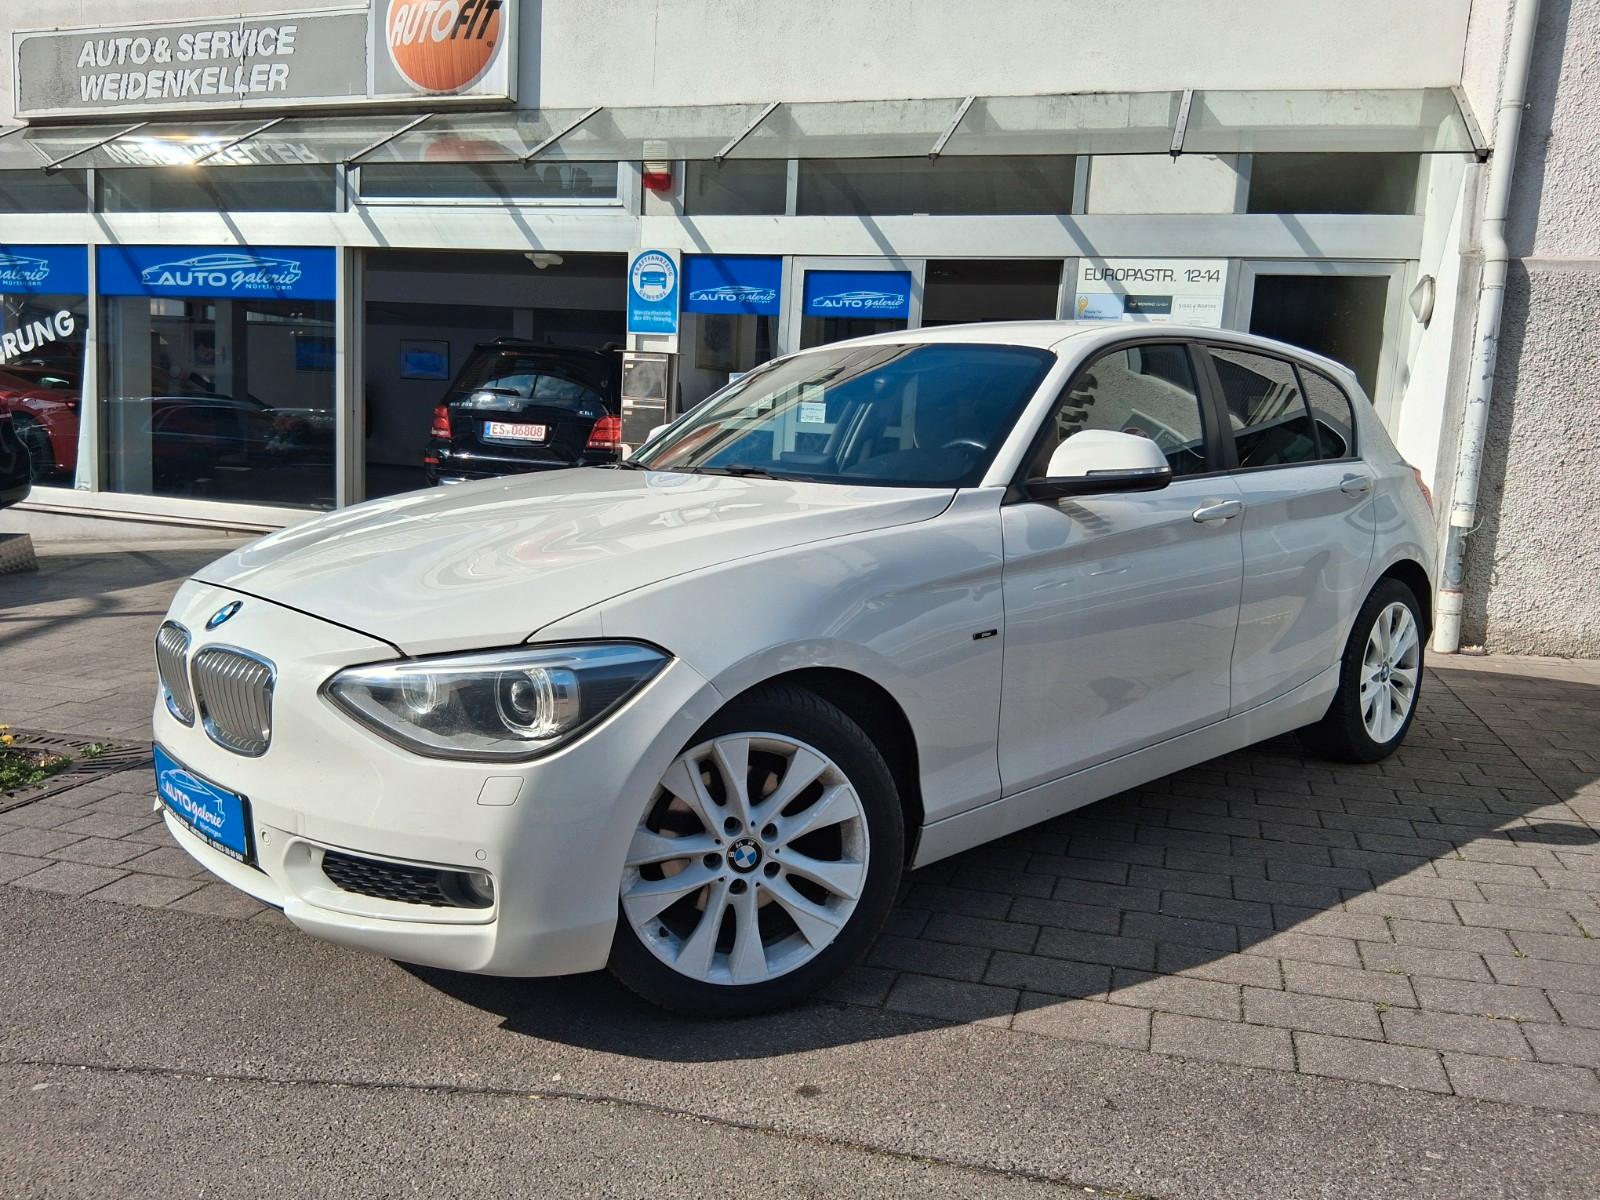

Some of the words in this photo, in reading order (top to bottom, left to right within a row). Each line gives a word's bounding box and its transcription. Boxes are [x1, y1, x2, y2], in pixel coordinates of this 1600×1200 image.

[391, 0, 504, 47] AUTOFIT
[77, 37, 151, 68] AUTO
[152, 37, 172, 64] &
[176, 25, 298, 62] SERVICE
[80, 63, 289, 102] WEIDENKELLER
[0, 266, 47, 281] alerie
[158, 271, 228, 287] AUTO
[231, 267, 297, 290] galerie
[1084, 267, 1177, 282] EUROPASTR.
[1184, 268, 1221, 283] 12-14
[699, 293, 736, 302] AUTO
[822, 299, 862, 308] AUTO
[864, 297, 902, 309] galerie
[492, 424, 505, 435] ES
[512, 425, 543, 437] 06808
[163, 780, 192, 811] AUTO
[191, 801, 224, 828] galerie
